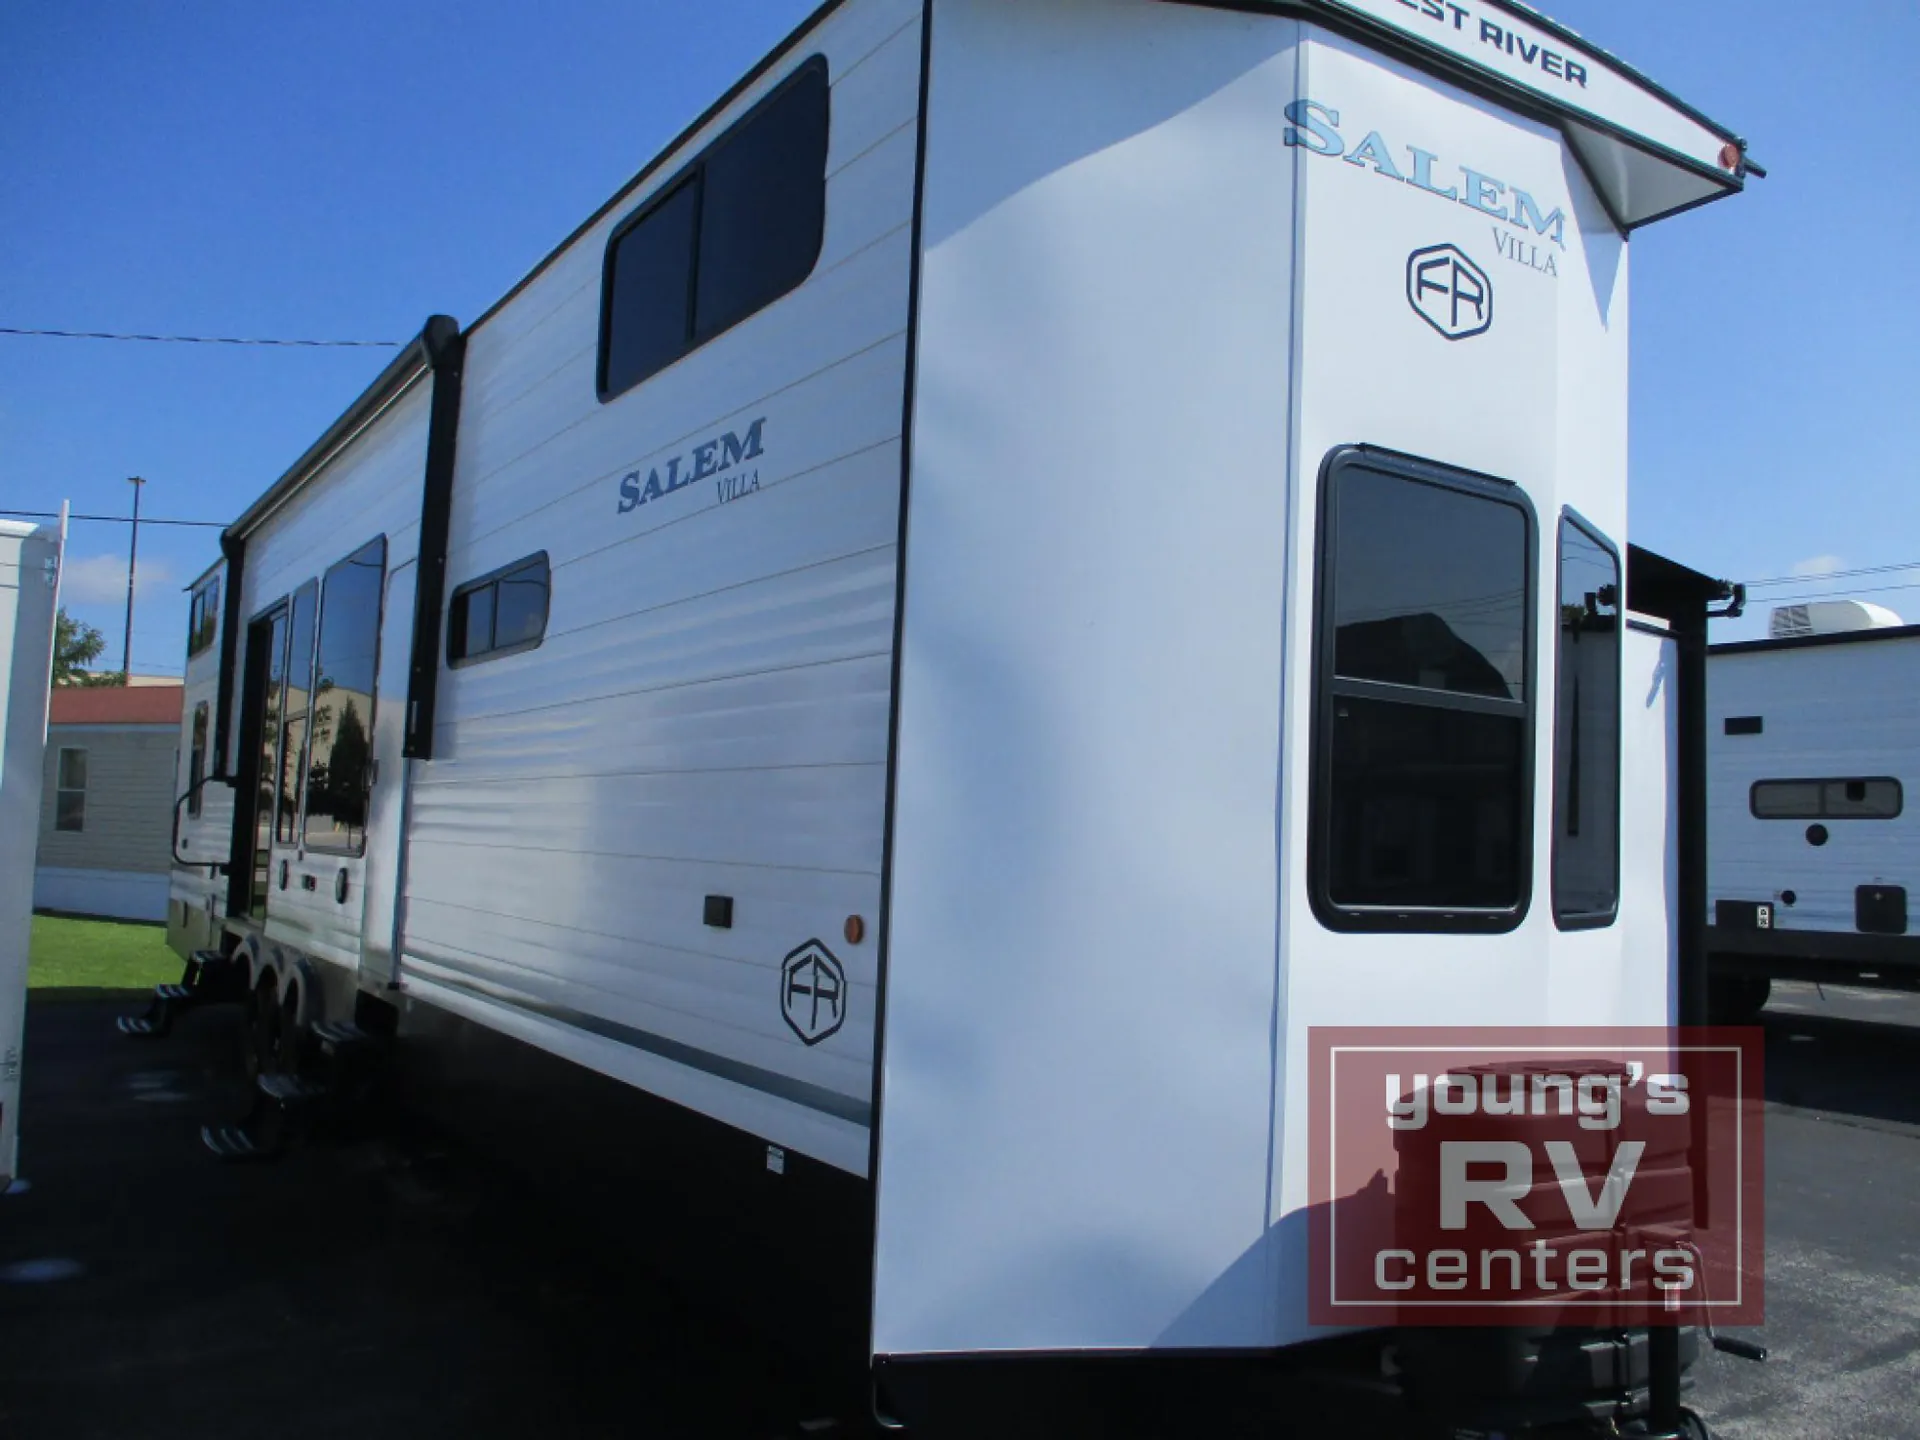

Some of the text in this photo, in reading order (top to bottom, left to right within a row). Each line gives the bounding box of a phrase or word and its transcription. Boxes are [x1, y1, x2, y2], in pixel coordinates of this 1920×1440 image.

[1479, 18, 1588, 88] RIVER
[1284, 98, 1566, 252] SALEM
[1491, 226, 1558, 278] VILLA
[617, 416, 767, 514] SALEM
[716, 468, 760, 505] VILLA
